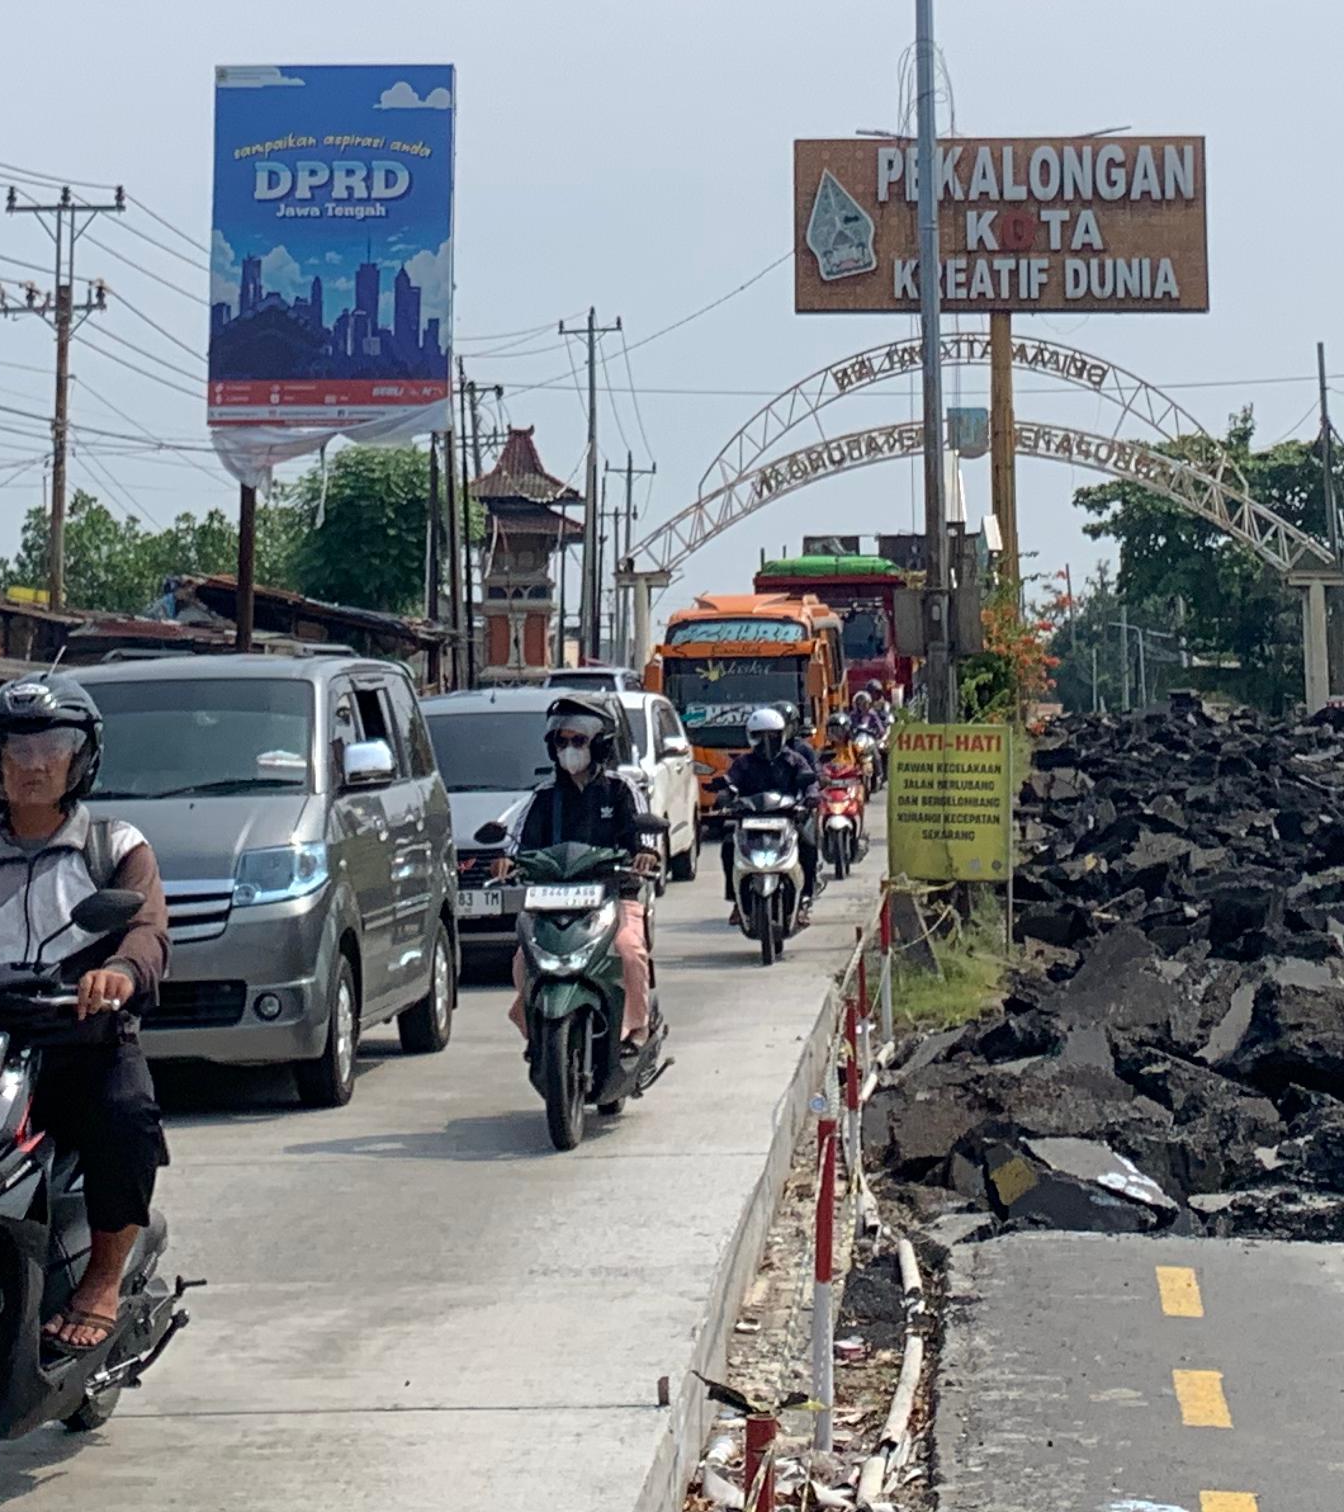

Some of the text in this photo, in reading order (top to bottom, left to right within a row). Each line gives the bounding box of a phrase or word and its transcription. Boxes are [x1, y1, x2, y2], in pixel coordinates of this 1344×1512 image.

[233, 133, 432, 159] sampaikan aspirasi anda
[253, 160, 411, 200] DPRD
[877, 144, 1195, 201] PEKALONGAN
[275, 202, 387, 220] Jawa Tengah
[965, 208, 1105, 251] KOTA
[893, 257, 1180, 300] KEATIF DUNIA
[897, 733, 1002, 753] HATI-HATI
[897, 762, 1001, 775] RAWAN KECELAKAAN
[904, 779, 995, 792] JALAN BERLUBANG
[897, 795, 919, 806] DAN
[897, 813, 1001, 825] KURANGI KECEPATAN
[922, 829, 976, 841] SEKARANG
[484, 891, 500, 906] TM
